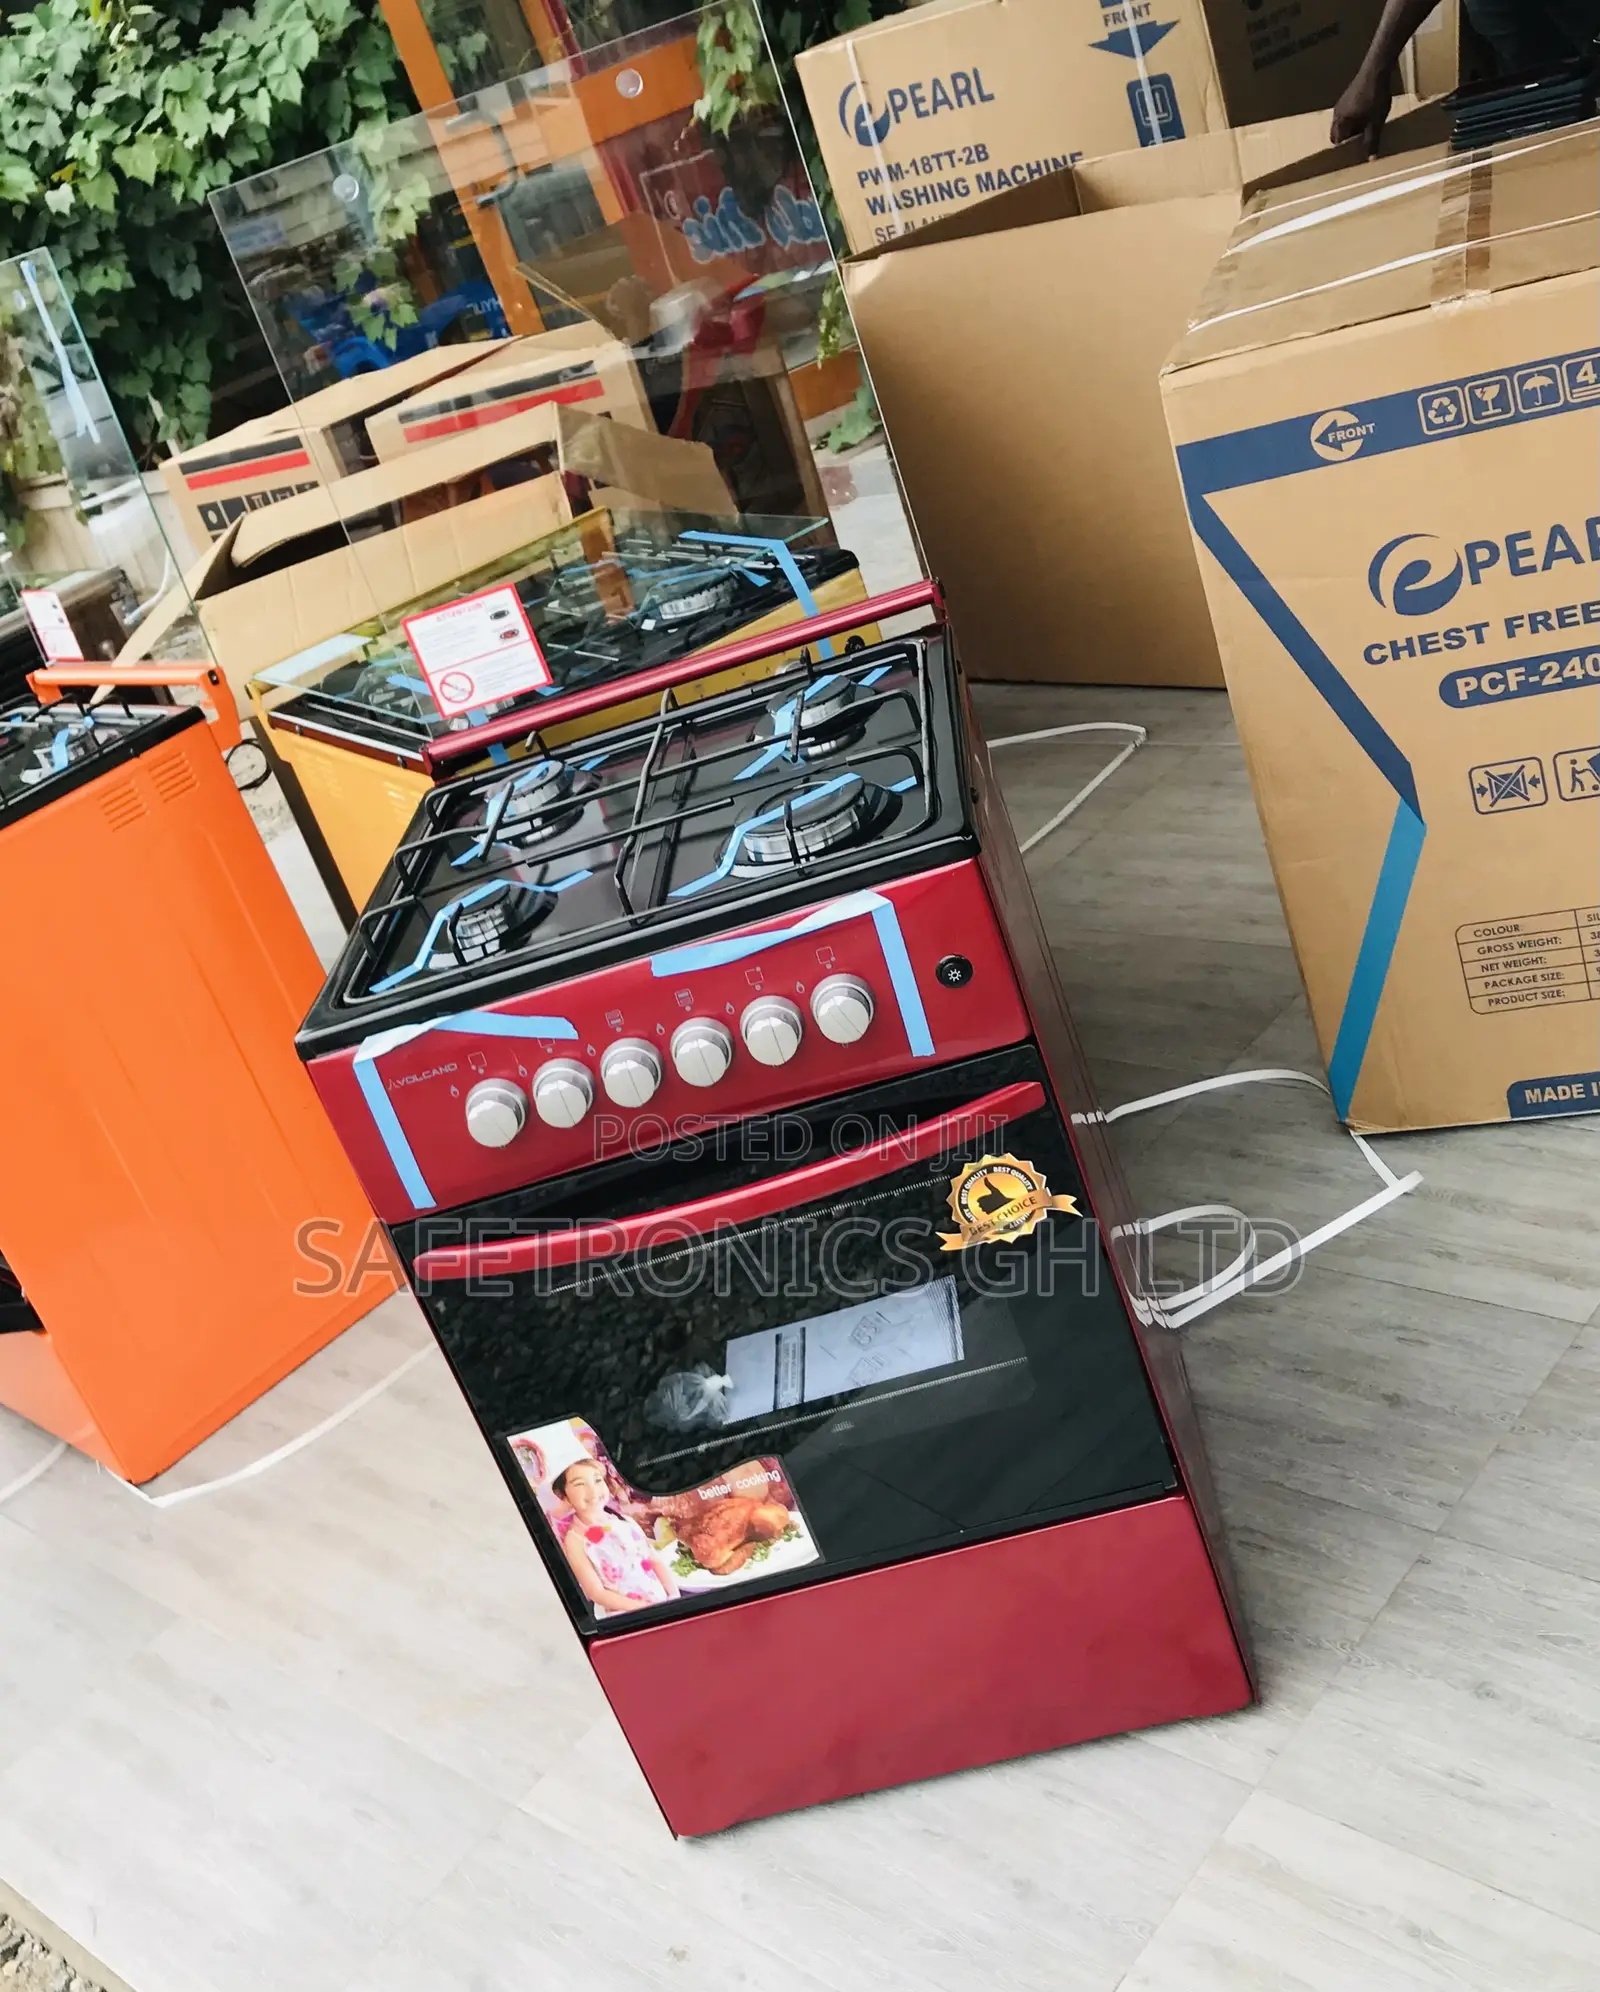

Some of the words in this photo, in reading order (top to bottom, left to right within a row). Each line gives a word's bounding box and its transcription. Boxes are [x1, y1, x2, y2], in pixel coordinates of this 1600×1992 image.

[888, 67, 995, 124] PEARL
[1327, 422, 1376, 443] FRONT
[1363, 621, 1490, 666] CHEST
[1477, 942, 1515, 955] GROSS
[1517, 936, 1562, 949] WEIGHT:
[1480, 962, 1500, 973] NET
[1502, 956, 1547, 969] WEIGHT:
[1484, 974, 1538, 990] PACKAGE
[1540, 971, 1565, 982] SIZE:
[1488, 992, 1538, 1007] PRODUCT
[396, 1062, 458, 1087] VOLCANO
[1524, 1083, 1586, 1105] MADE
[960, 1190, 968, 1205] BEST
[965, 1168, 988, 1190] QUALITY
[1010, 1169, 1034, 1190] QUALITY
[968, 1219, 997, 1236] BEST
[997, 1195, 1037, 1221] CHOICE
[697, 1482, 732, 1500] better
[735, 1469, 782, 1489] cooking
